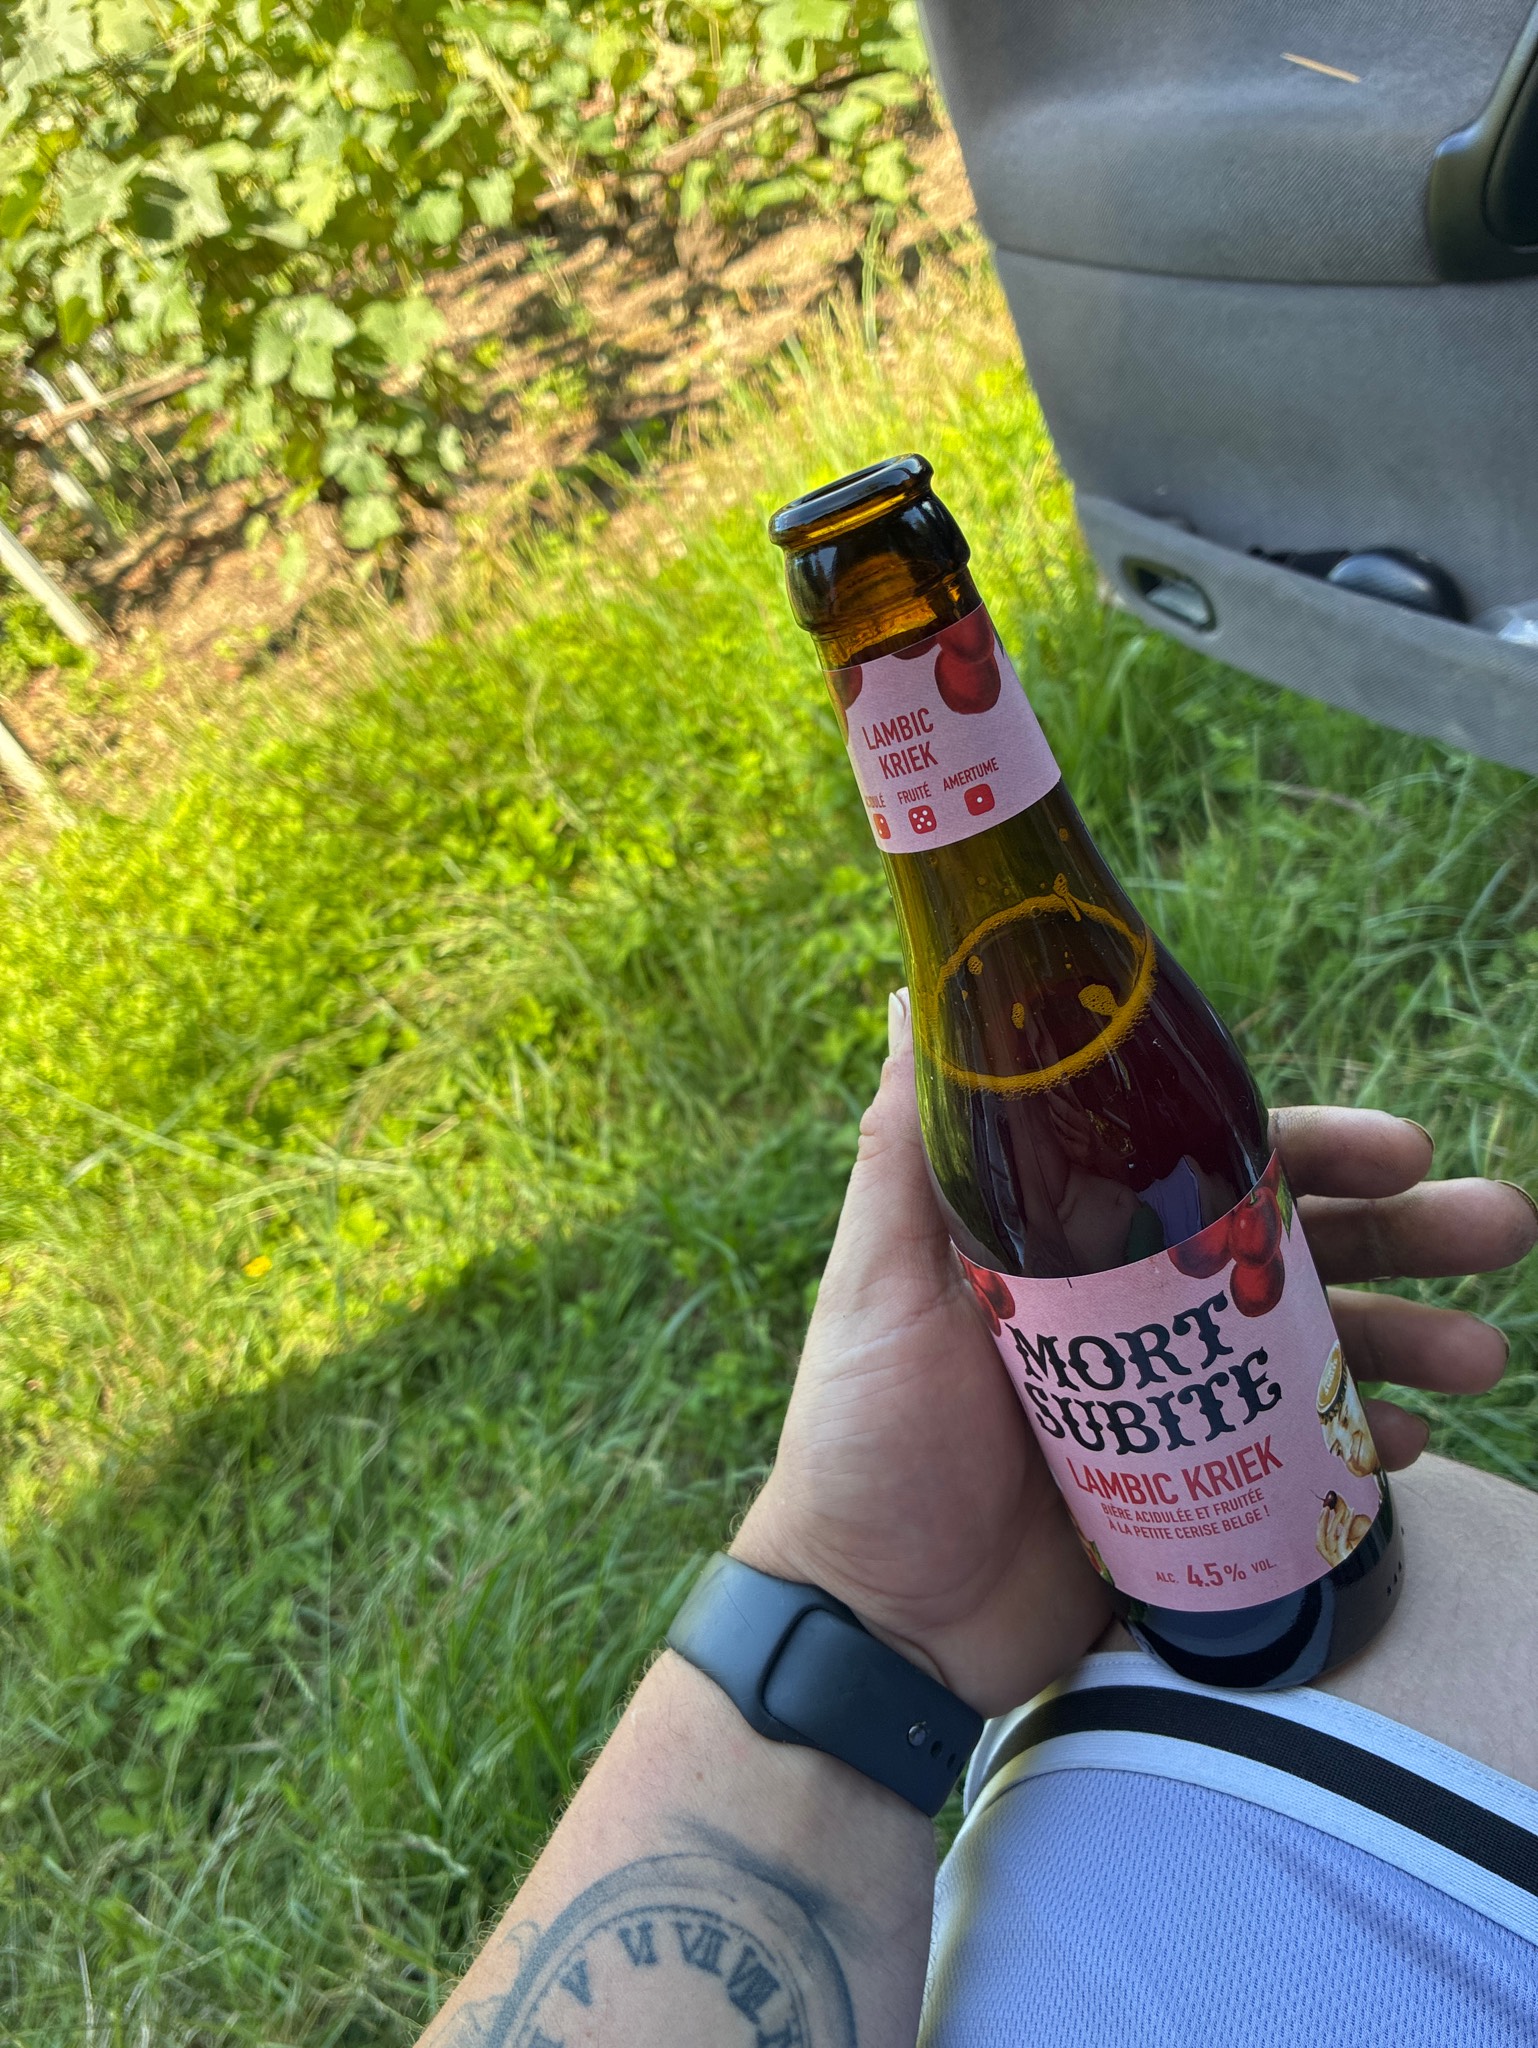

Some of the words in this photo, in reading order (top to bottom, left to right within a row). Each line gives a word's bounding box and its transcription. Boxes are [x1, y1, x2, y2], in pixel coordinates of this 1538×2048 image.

[862, 708, 934, 750] LAMBIC
[878, 741, 938, 779] KRIEK
[943, 757, 1000, 791] AMERTUME
[897, 781, 932, 805] FRUITÉ
[1005, 1290, 1234, 1392] MORT
[1025, 1346, 1283, 1456] SUBITE
[1066, 1457, 1178, 1506] LAMBIC
[1181, 1435, 1284, 1501] KRIEK
[1101, 1502, 1133, 1521] BIÈRE
[1135, 1507, 1194, 1524] ACIDULÉE
[1195, 1506, 1214, 1520] ET
[1213, 1488, 1265, 1516] FRUITÉE
[1114, 1521, 1133, 1536] LA
[1134, 1526, 1173, 1540] PETITE
[1175, 1520, 1221, 1540] CERISE
[1222, 1508, 1263, 1532] BELGE
[1155, 1571, 1179, 1584] ALC.
[1251, 1558, 1278, 1574] VOL.
